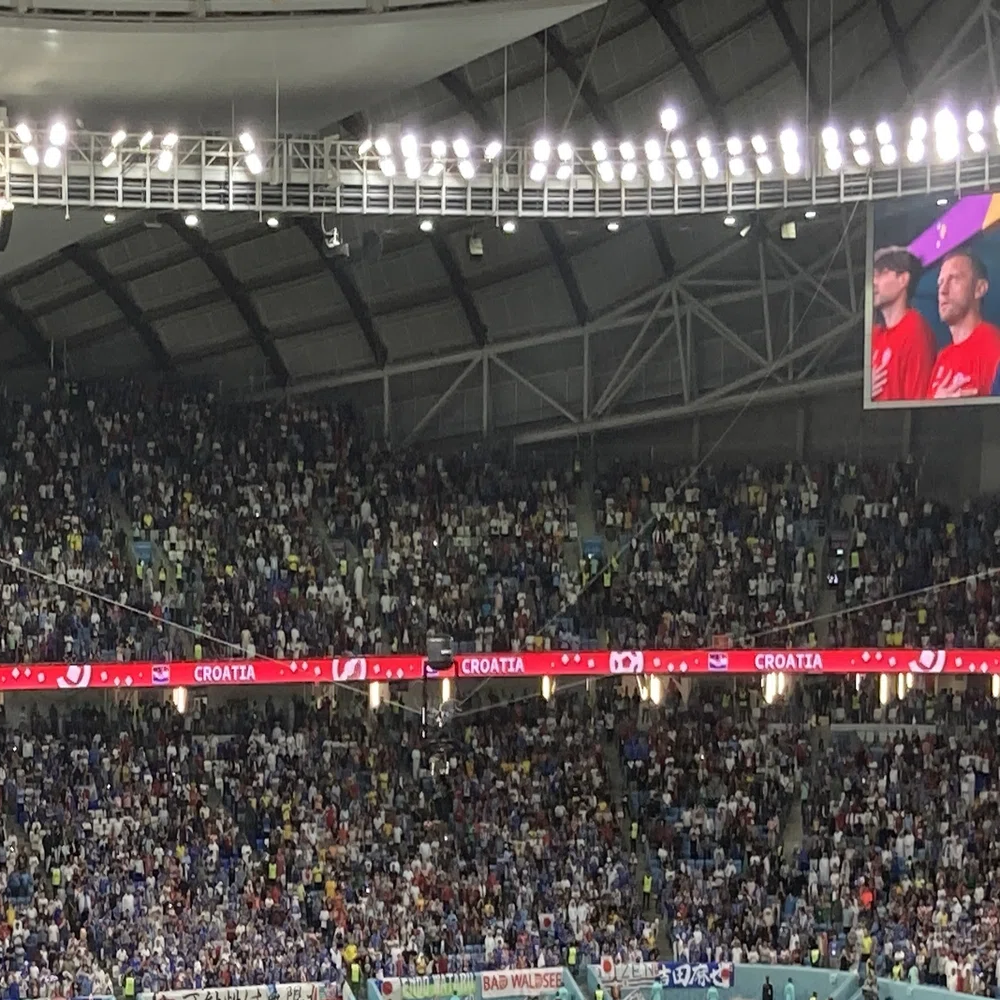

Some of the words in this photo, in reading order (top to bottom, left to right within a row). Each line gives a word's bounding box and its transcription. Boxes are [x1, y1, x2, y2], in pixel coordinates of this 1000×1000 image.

[462, 657, 524, 675] CROATIA
[755, 653, 823, 670] CROATIA
[194, 664, 256, 682] CROATIA
